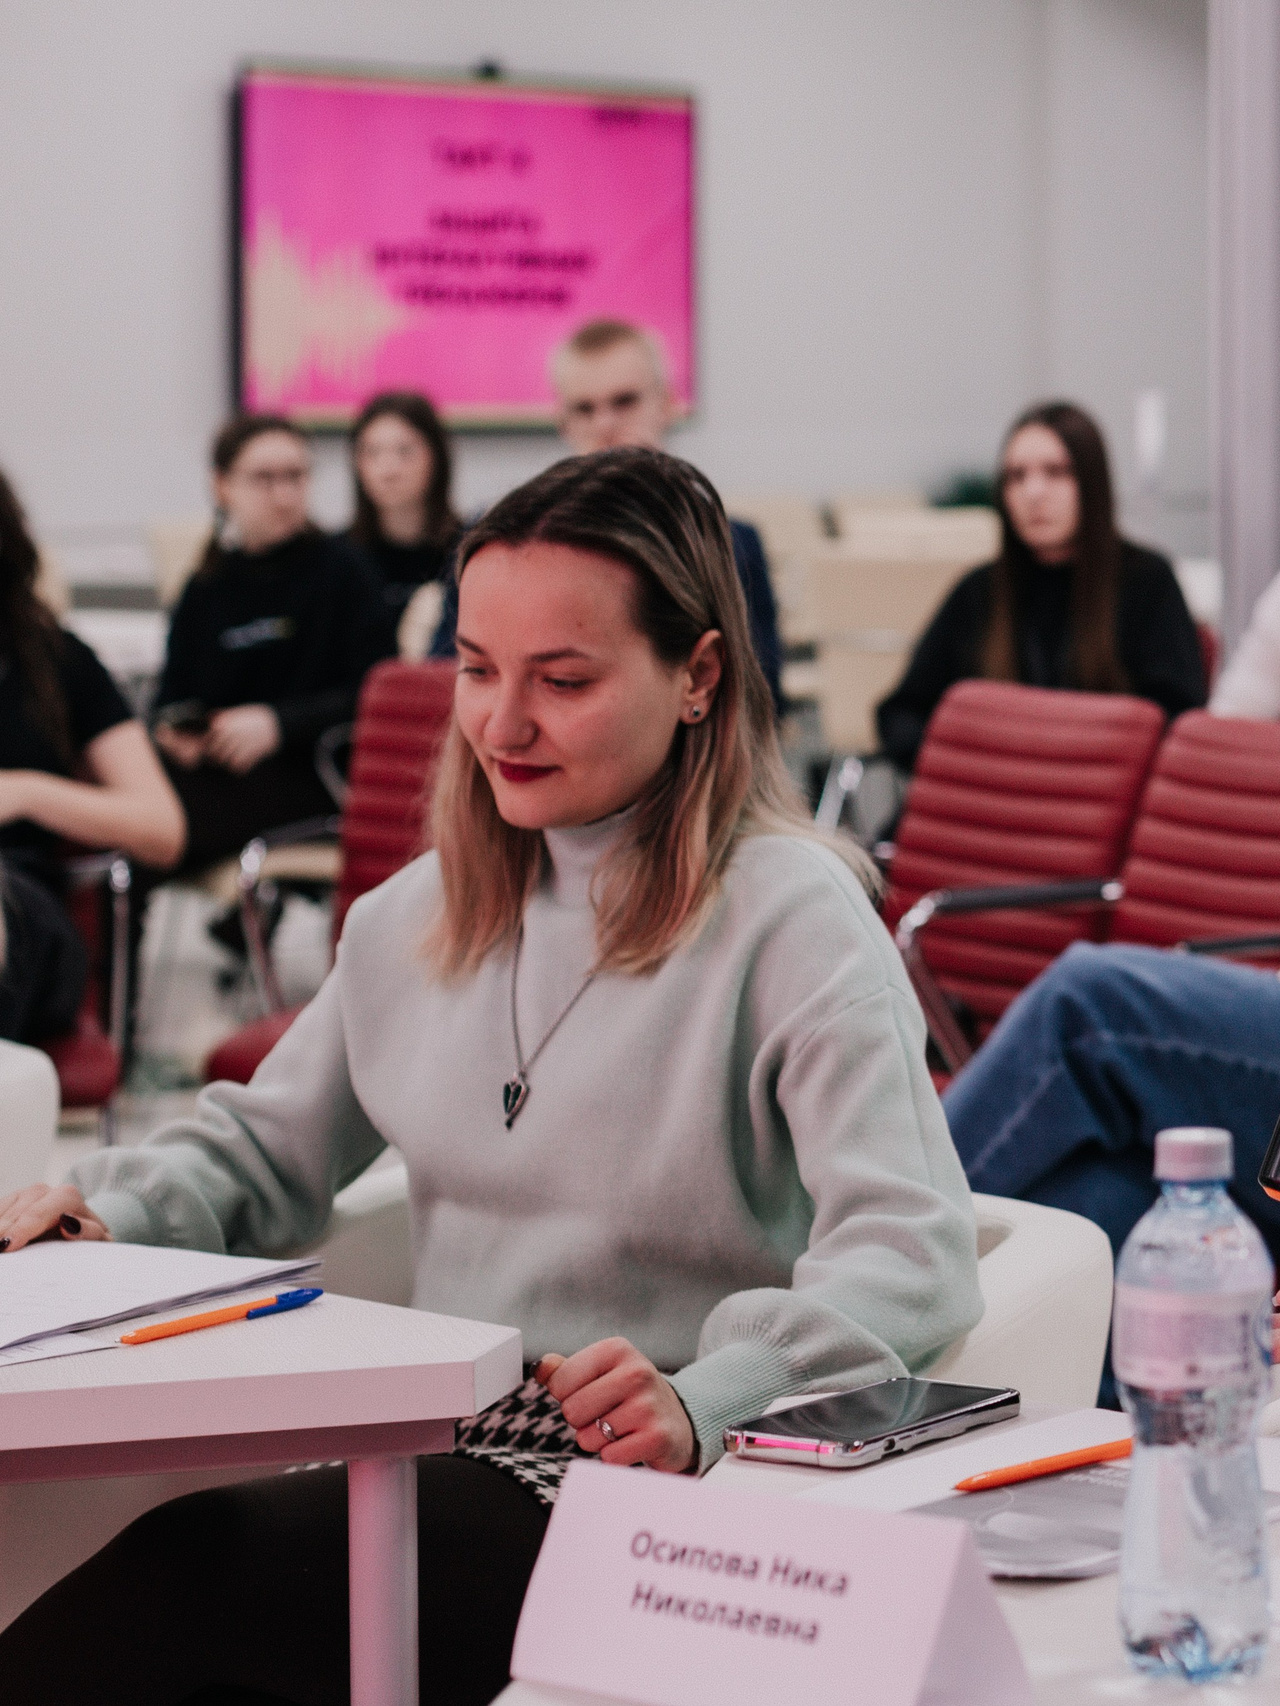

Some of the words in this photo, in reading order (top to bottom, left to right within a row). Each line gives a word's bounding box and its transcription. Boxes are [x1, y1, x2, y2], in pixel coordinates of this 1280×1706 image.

[631, 1531, 759, 1579] Осипова
[769, 1556, 850, 1596] Ника
[631, 1581, 819, 1644] Николаевна
